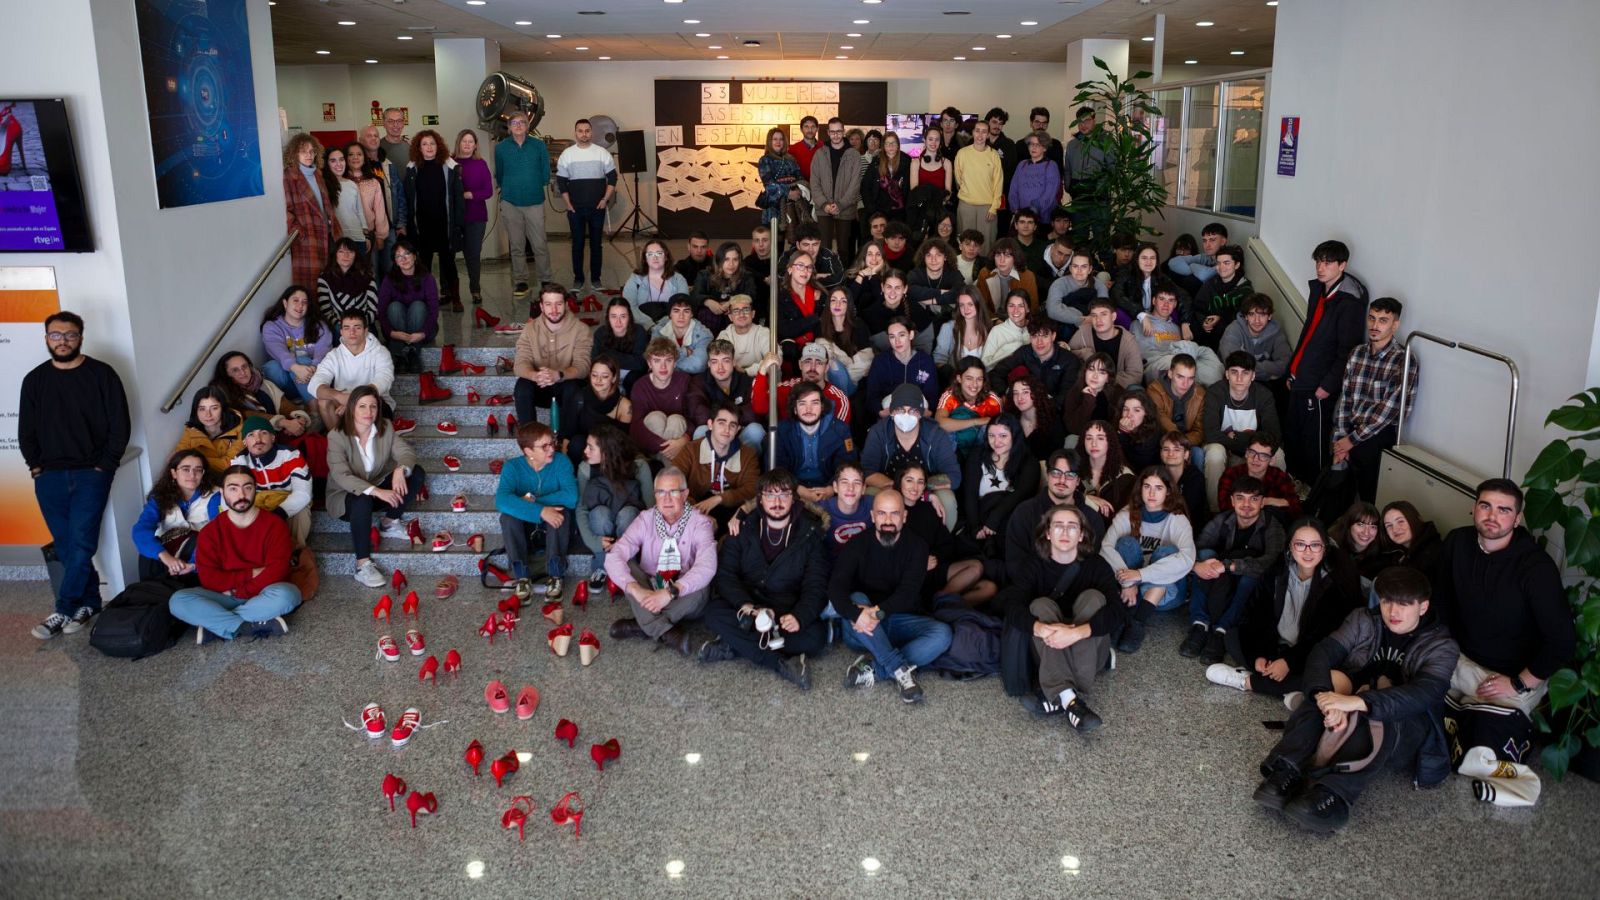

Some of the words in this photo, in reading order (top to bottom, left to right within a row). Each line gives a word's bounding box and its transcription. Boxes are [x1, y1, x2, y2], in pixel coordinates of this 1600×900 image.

[703, 86, 727, 100] 53
[743, 85, 838, 101] MUJERES
[656, 128, 680, 144] EN
[696, 126, 770, 144] ESPAÑ
[33, 235, 51, 245] rtve
